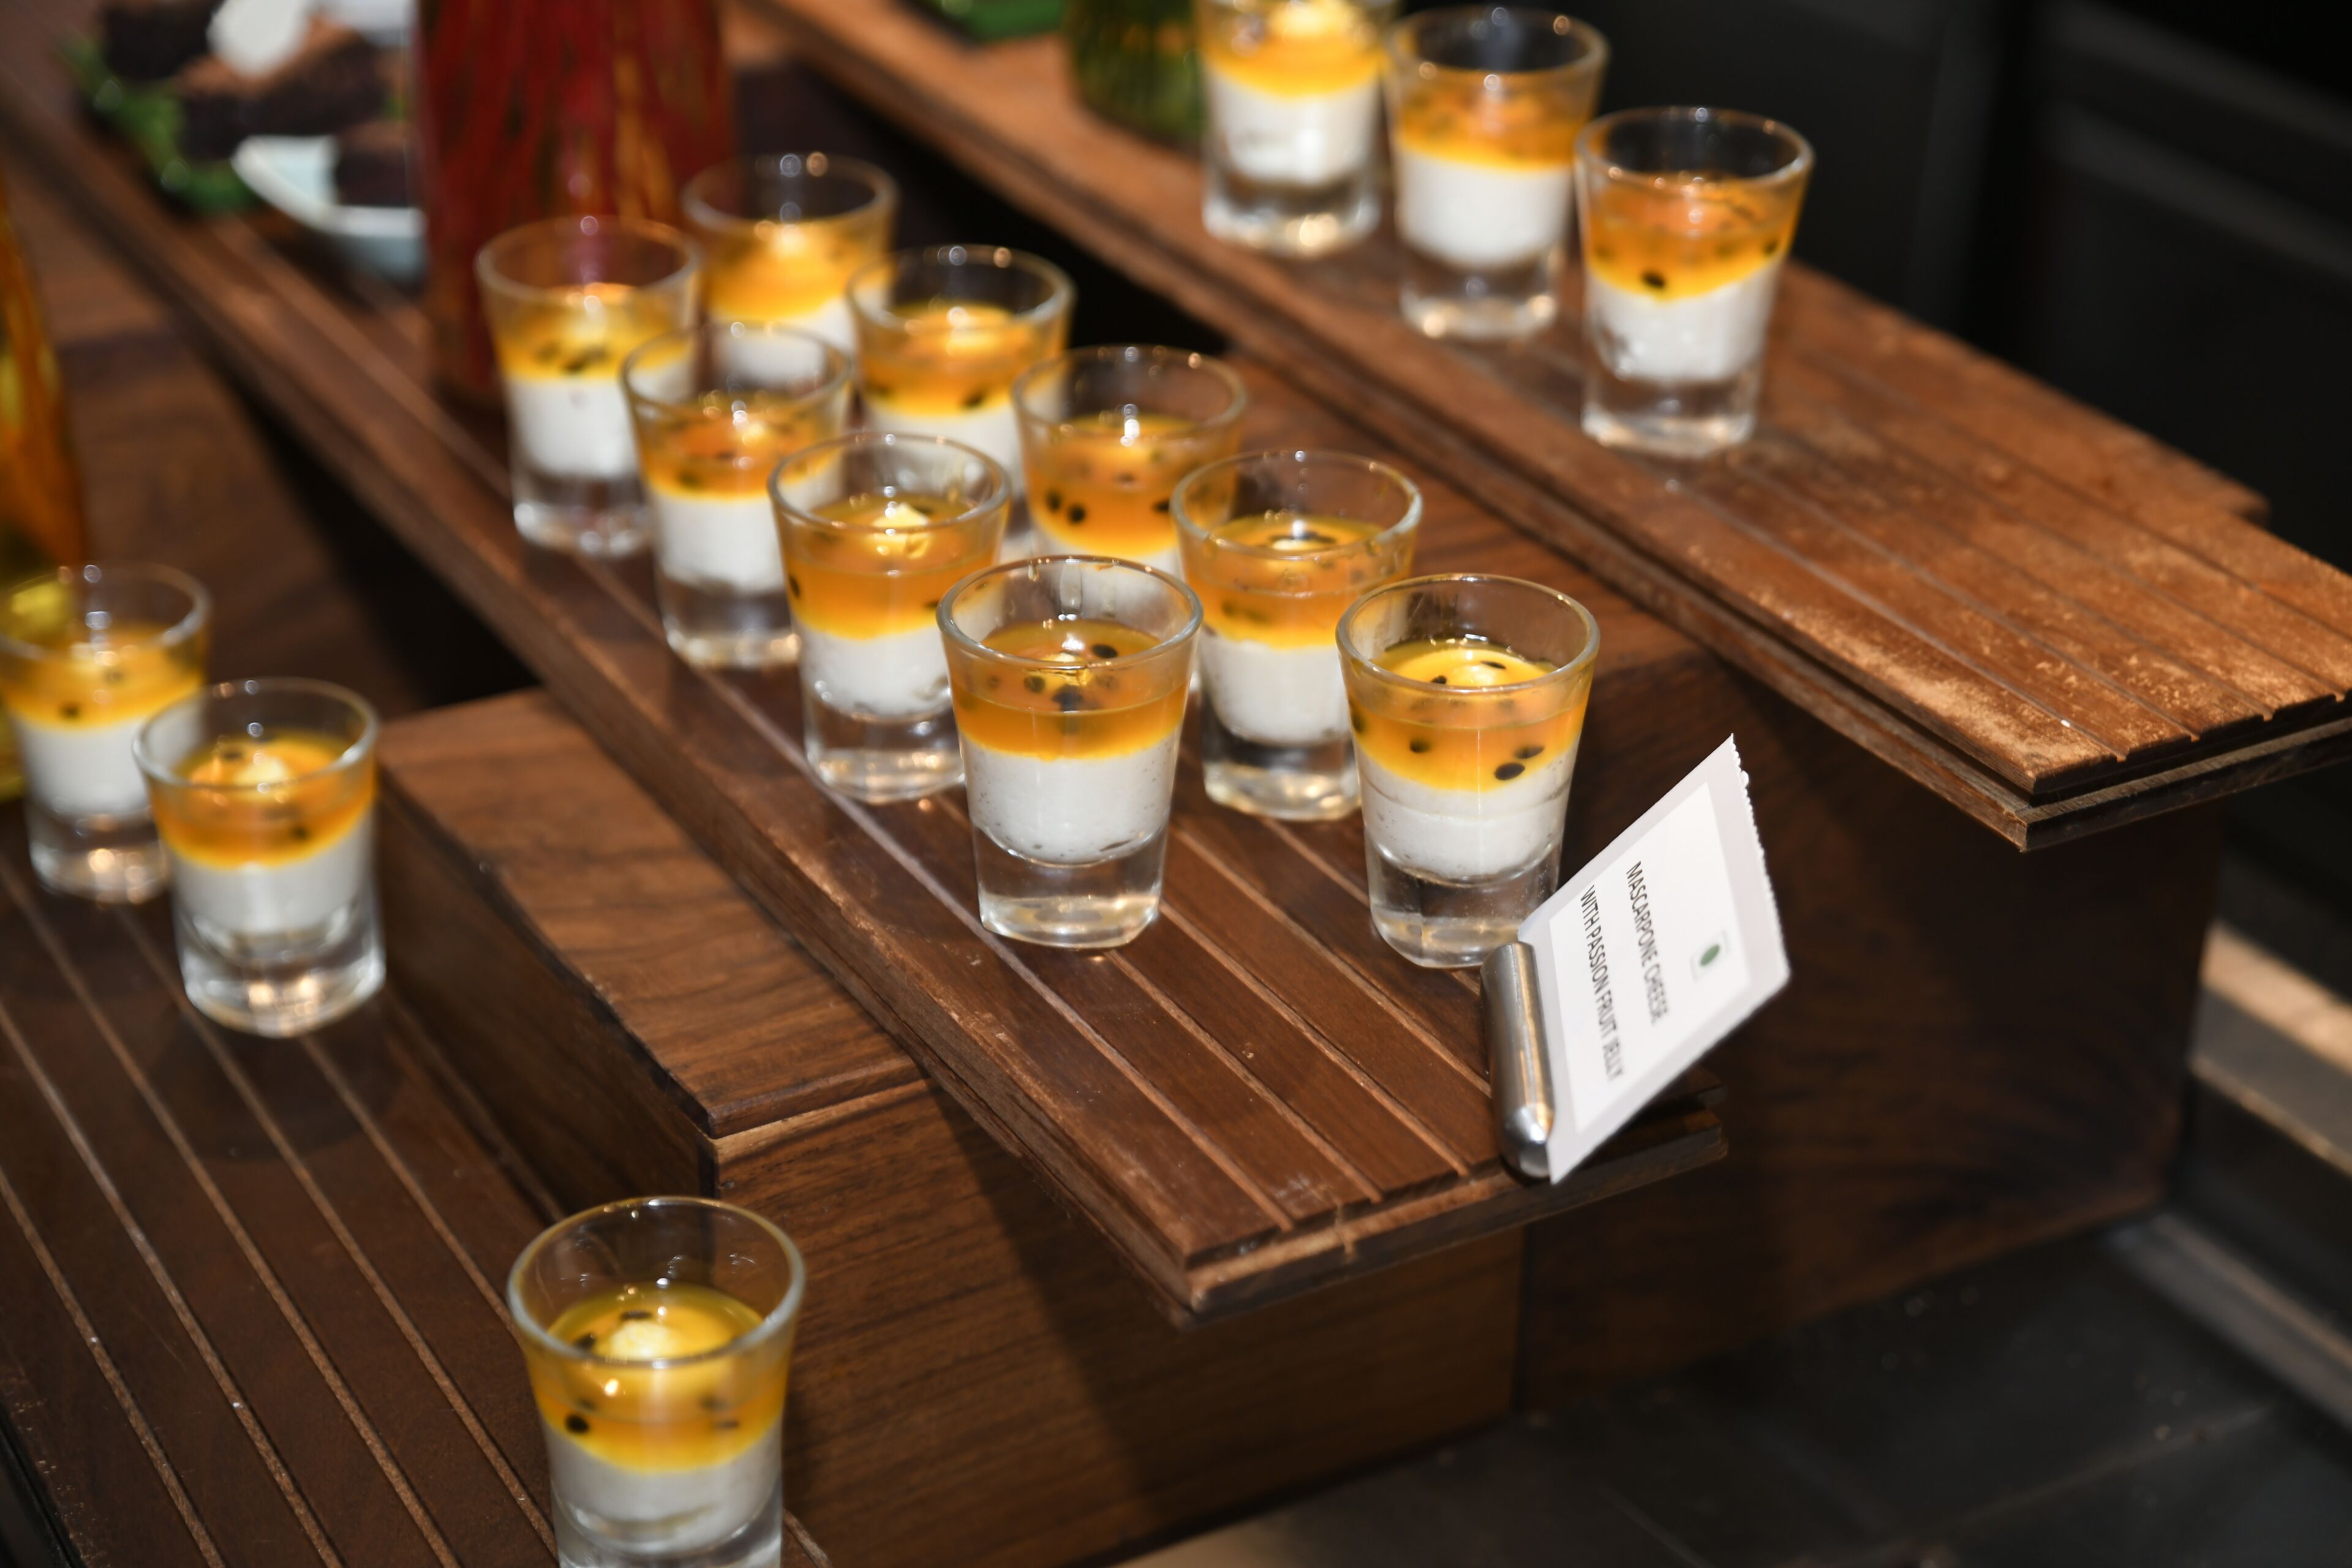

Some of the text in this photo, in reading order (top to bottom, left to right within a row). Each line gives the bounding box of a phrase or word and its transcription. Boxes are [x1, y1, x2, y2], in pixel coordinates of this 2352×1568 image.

[1580, 884, 1624, 1082] WITH PASSION FRUIT JELLY
[1626, 860, 1668, 1024] MASCARPONE CHEESE
